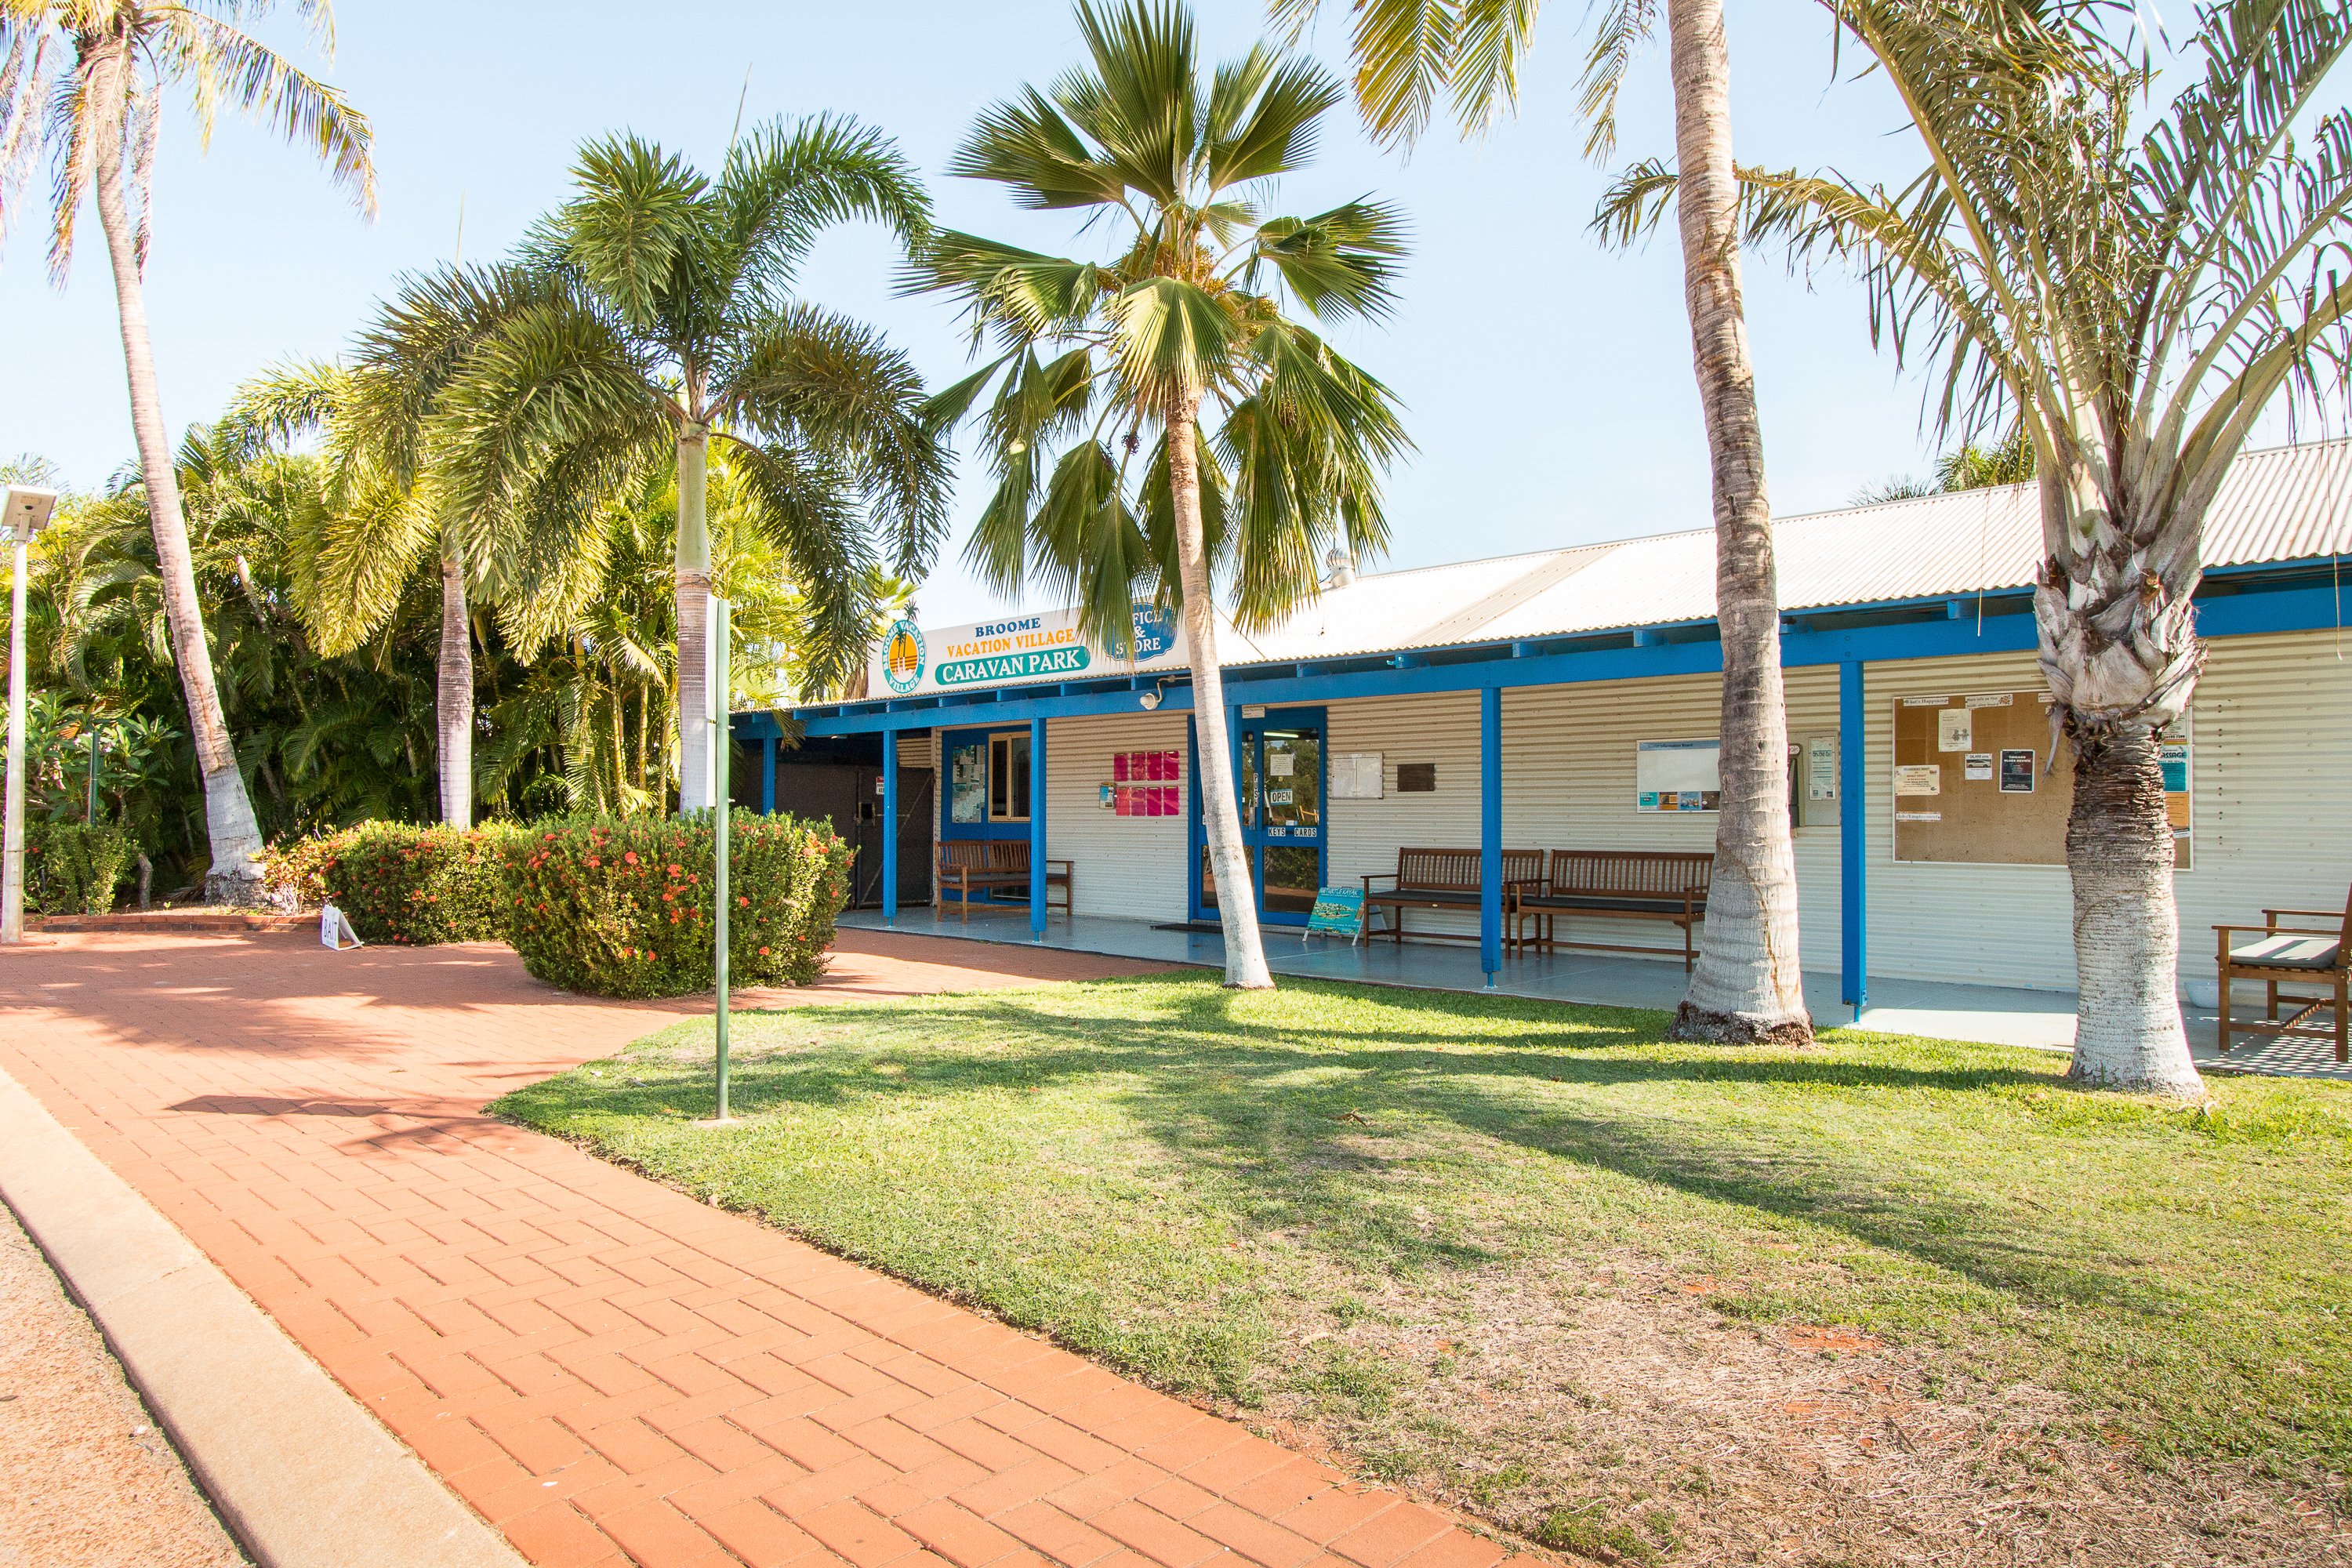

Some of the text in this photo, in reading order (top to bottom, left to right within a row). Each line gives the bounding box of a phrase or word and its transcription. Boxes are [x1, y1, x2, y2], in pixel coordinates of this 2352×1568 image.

[975, 617, 1041, 637] BROOME
[1134, 626, 1146, 639] &
[883, 622, 925, 670] BROOME VACATION
[947, 628, 1075, 658] VACATION VILLAGE
[1116, 637, 1161, 655] SORE
[942, 649, 1081, 683] CARAVAN PARK
[889, 674, 920, 693] VILLAGE
[1272, 791, 1291, 802] OPEN
[1294, 828, 1316, 837] CARDS
[324, 918, 338, 941] BAIT
